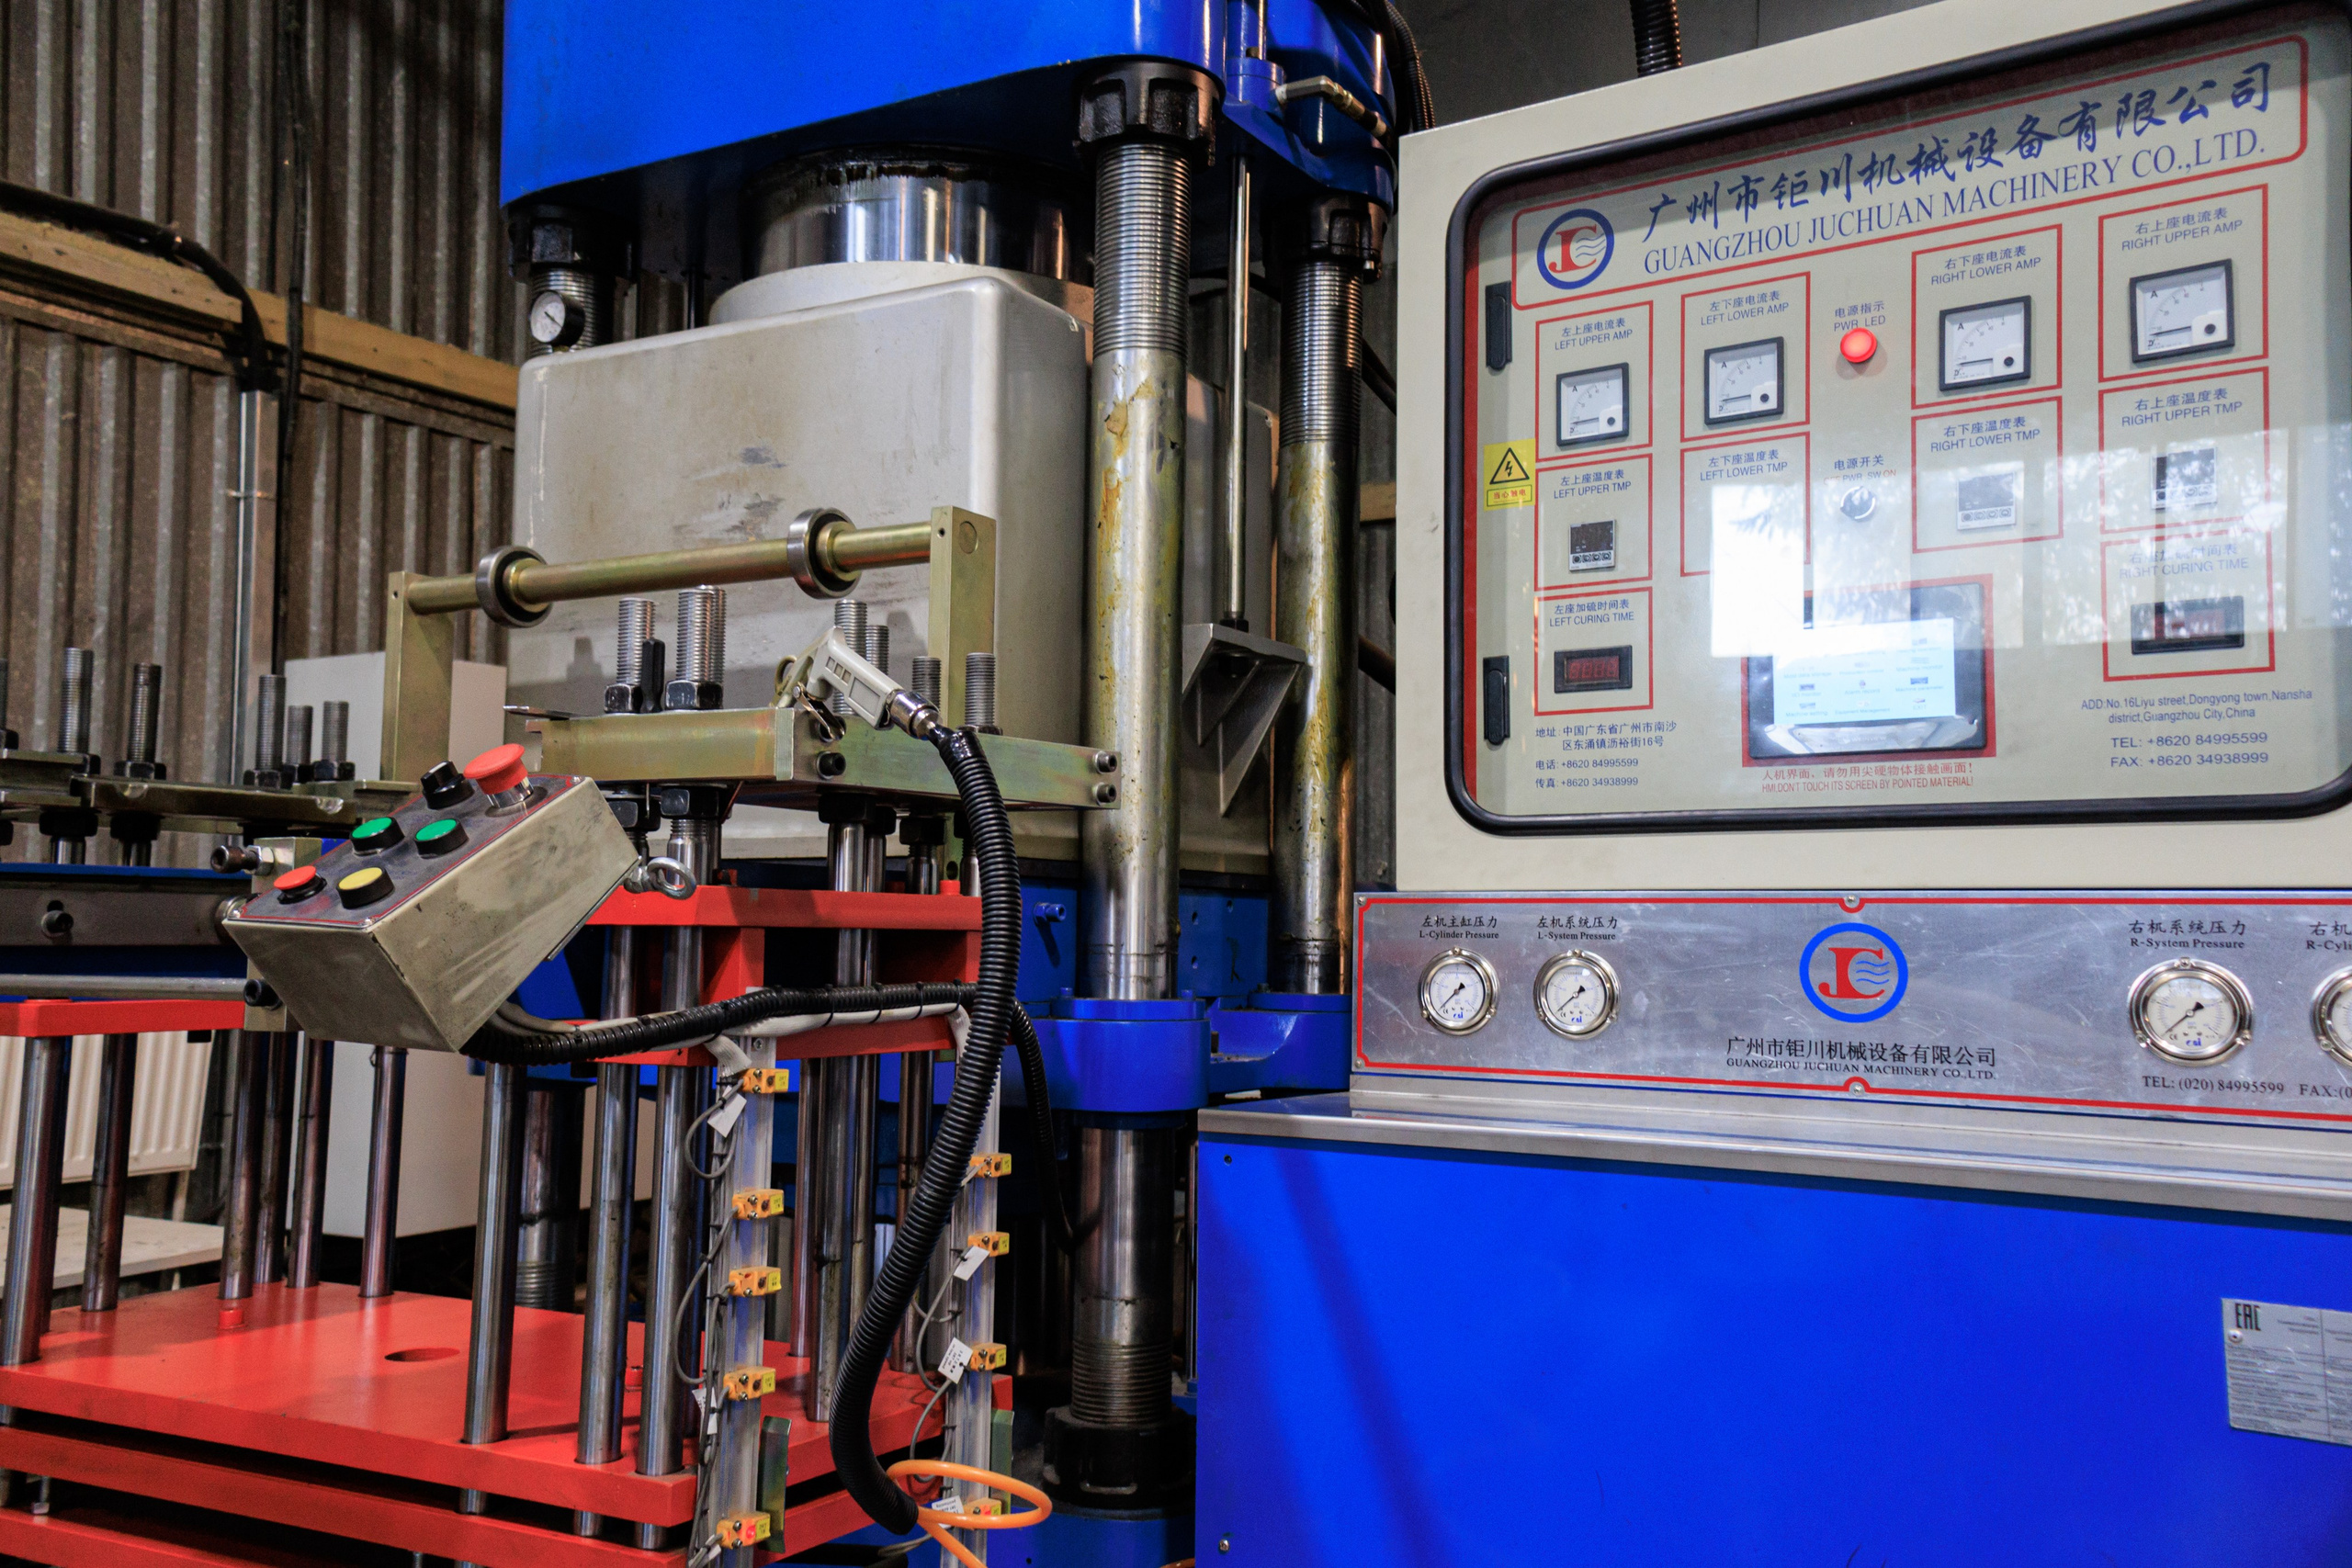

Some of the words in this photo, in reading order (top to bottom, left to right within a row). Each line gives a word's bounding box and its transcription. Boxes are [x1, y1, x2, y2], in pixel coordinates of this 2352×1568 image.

[1642, 62, 2271, 243] 广州市钜川机械设备有限公司
[1644, 222, 1801, 274] GUANGZHOU
[1808, 195, 1933, 243] JUCHUAN
[1942, 155, 2122, 217] MACHINERY
[2132, 129, 2265, 177] CO.,LTD.
[2135, 207, 2228, 234] 右上座电流表
[2121, 235, 2161, 251] RIGHT
[2165, 226, 2210, 243] UPPER
[2213, 220, 2243, 234] AMP
[1944, 245, 2026, 270] 右下座电流表
[1931, 270, 1965, 286] RIGHT
[1969, 263, 2012, 279] LOWER
[2015, 256, 2041, 270] AMP
[1709, 290, 1781, 312] 左下座电流表
[1835, 300, 1884, 318] 电源指示
[1701, 312, 1724, 326] LEFT
[1727, 306, 1764, 322] LOWER
[1767, 302, 1789, 316] AMP
[1562, 317, 1626, 337] 左上座电流表
[1834, 320, 1859, 332] PWR
[1865, 315, 1886, 327] LED
[1555, 338, 1577, 351] LEFT
[1579, 333, 1611, 347] UPPER
[1612, 329, 1633, 342] AMP
[2135, 388, 2228, 412] 右上座温度表
[2121, 412, 2161, 427] RIGHT
[2165, 405, 2211, 422] UPPER
[2214, 401, 2243, 414] TMP
[1944, 416, 2026, 437] 右下座温度表
[1930, 438, 1965, 452] RIGHT
[1969, 433, 2012, 447] LOWER
[2015, 428, 2041, 441] TMP
[1708, 449, 1779, 467] 左下座温度表
[1834, 454, 1883, 470] 电源开关
[1561, 468, 1624, 486] 左上座温度表
[1700, 468, 1724, 481] LEFT
[1726, 465, 1763, 479] LOWER
[1766, 462, 1788, 474] TMP
[1843, 473, 1862, 482] PWR
[1868, 471, 1881, 479] SW
[1883, 469, 1896, 478] ON
[1554, 486, 1576, 499] LEFT
[1577, 483, 1609, 497] UPPER
[1611, 481, 1632, 492] TMP
[2119, 565, 2158, 580] RIGHT
[2162, 559, 2213, 575] CURING
[2218, 558, 2249, 570] TIME
[1555, 598, 1630, 615] 左座加硫时间表
[1550, 615, 1572, 627] LEFT
[1574, 613, 1610, 626] CURING
[1612, 611, 1634, 623] TIME
[2110, 737, 2142, 748] TEL:
[2147, 735, 2190, 746] +8620
[2195, 732, 2267, 745] 84995599
[1562, 760, 1589, 769] +8620
[1592, 758, 1639, 768] 84995599
[2110, 756, 2143, 768] FAX:
[2148, 754, 2191, 766] +8620
[2196, 751, 2268, 765] 34938999
[1562, 778, 1589, 787] +8620
[1592, 777, 1639, 786] 34938999
[1803, 781, 1829, 792] TOUCH
[1831, 780, 1843, 790] ITS
[1845, 779, 1877, 790] SCREEN
[1880, 779, 1890, 789] BY
[1893, 777, 1928, 788] POINTED
[1930, 776, 1973, 787] MATERIAL!
[1421, 915, 1498, 929] 左机主缸压力
[1536, 915, 1618, 930] 左机系统压力
[2129, 919, 2246, 936] 右机系统压力
[1419, 931, 1463, 940] L-Cylinder
[1464, 931, 1499, 940] Pressure
[1538, 931, 1578, 941] L-System
[1580, 931, 1616, 941] Pressure
[2131, 938, 2189, 949] R-System
[2193, 938, 2245, 949] Pressure
[1726, 1036, 1996, 1067] 广州市钜川机械设备有限公司
[1726, 1058, 1800, 1070] GUANGZHOU
[1804, 1062, 1860, 1073] JUCHUAN
[1864, 1066, 1938, 1077] MACHINERY
[1942, 1068, 1996, 1080] CO.,LTD.
[2143, 1076, 2175, 1089] TEL:
[2178, 1077, 2213, 1091] (020)
[2218, 1081, 2284, 1094] 84995599
